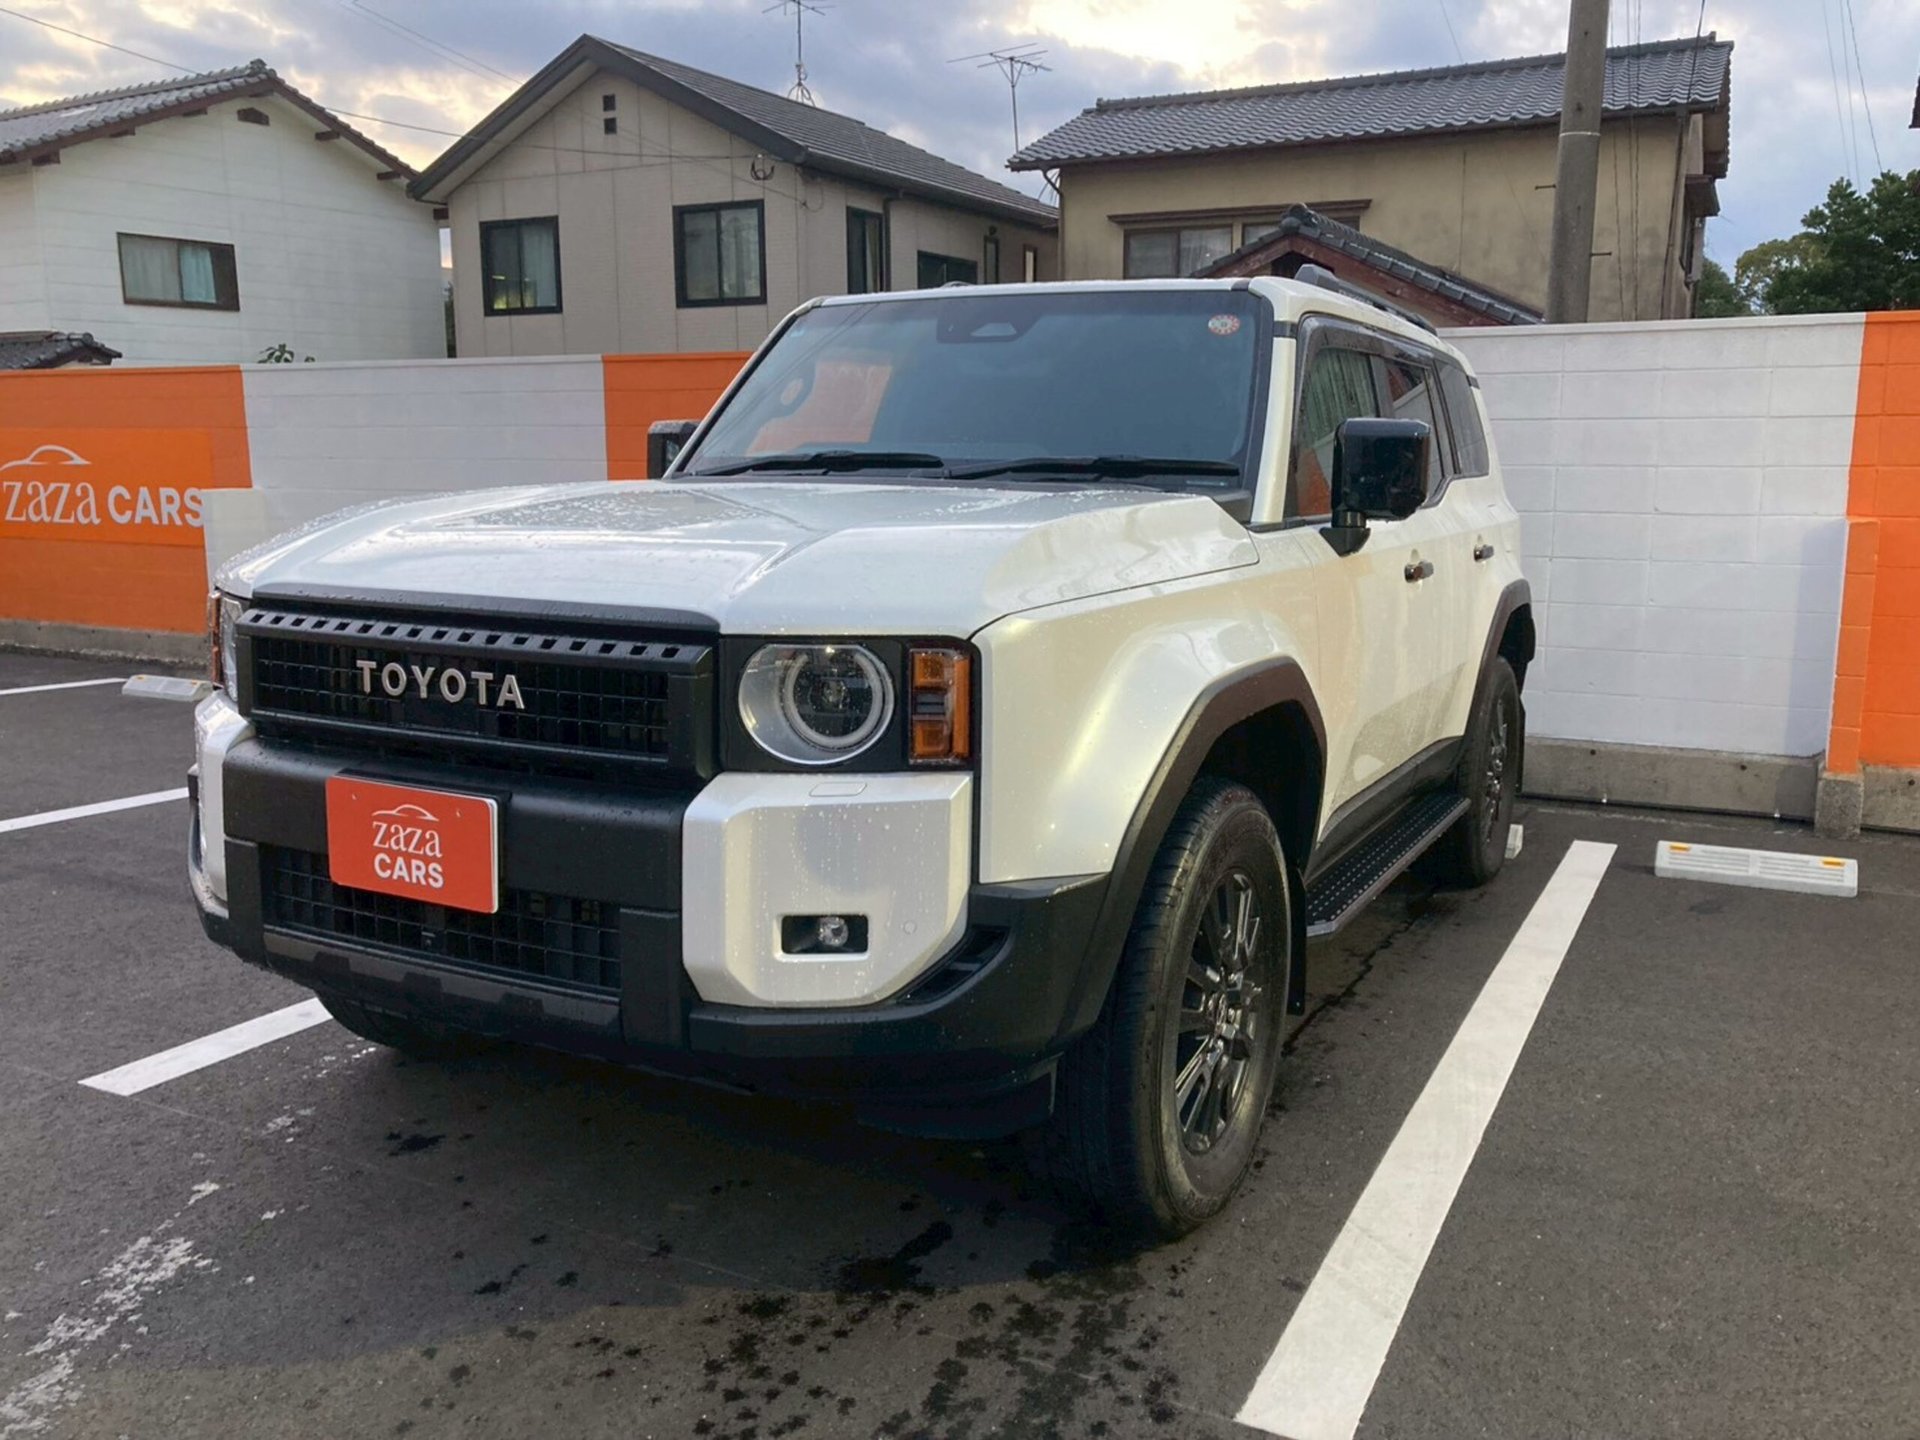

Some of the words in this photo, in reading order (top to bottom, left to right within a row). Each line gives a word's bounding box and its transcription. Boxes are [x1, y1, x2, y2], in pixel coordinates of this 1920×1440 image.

[3, 481, 101, 525] zaza
[107, 485, 204, 527] CARS
[356, 660, 525, 709] TOYOTA
[372, 821, 443, 858] zaza
[373, 853, 444, 888] CARS
